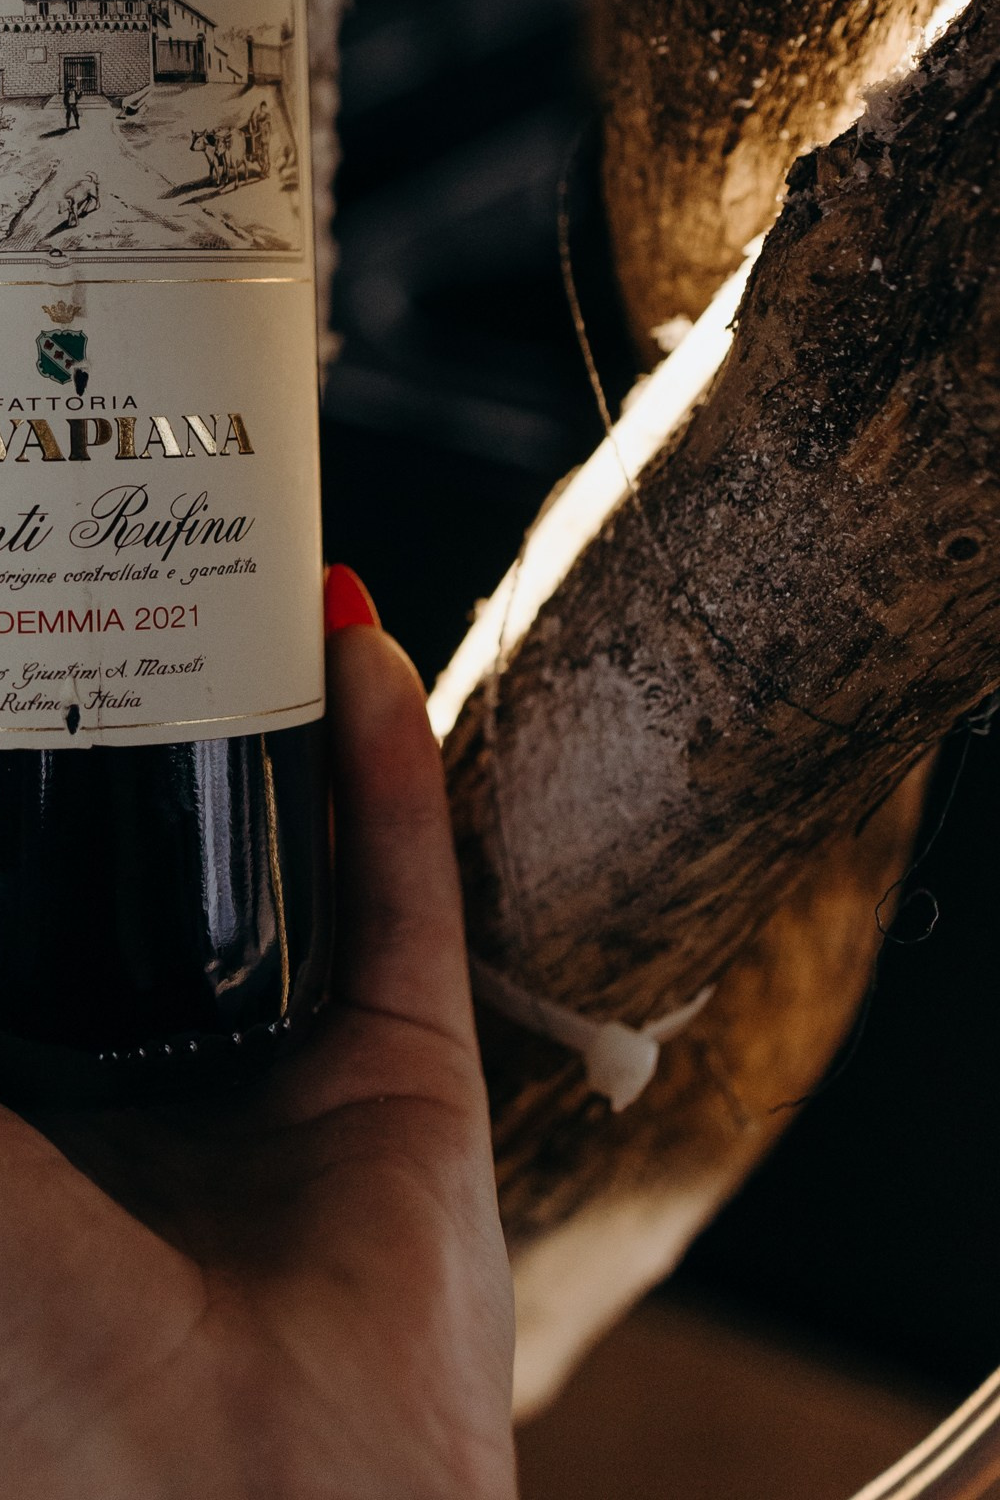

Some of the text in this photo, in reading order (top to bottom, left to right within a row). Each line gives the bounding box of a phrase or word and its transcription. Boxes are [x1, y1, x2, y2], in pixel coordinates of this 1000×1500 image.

[69, 484, 256, 562] Rufina
[63, 564, 159, 583] controllata
[166, 569, 177, 579] e
[180, 557, 258, 585] garantita
[135, 605, 199, 630] 2021
[12, 661, 98, 689] Giuntini
[105, 660, 128, 678] A.
[135, 655, 207, 676] Masseti
[83, 689, 142, 710] Italia
